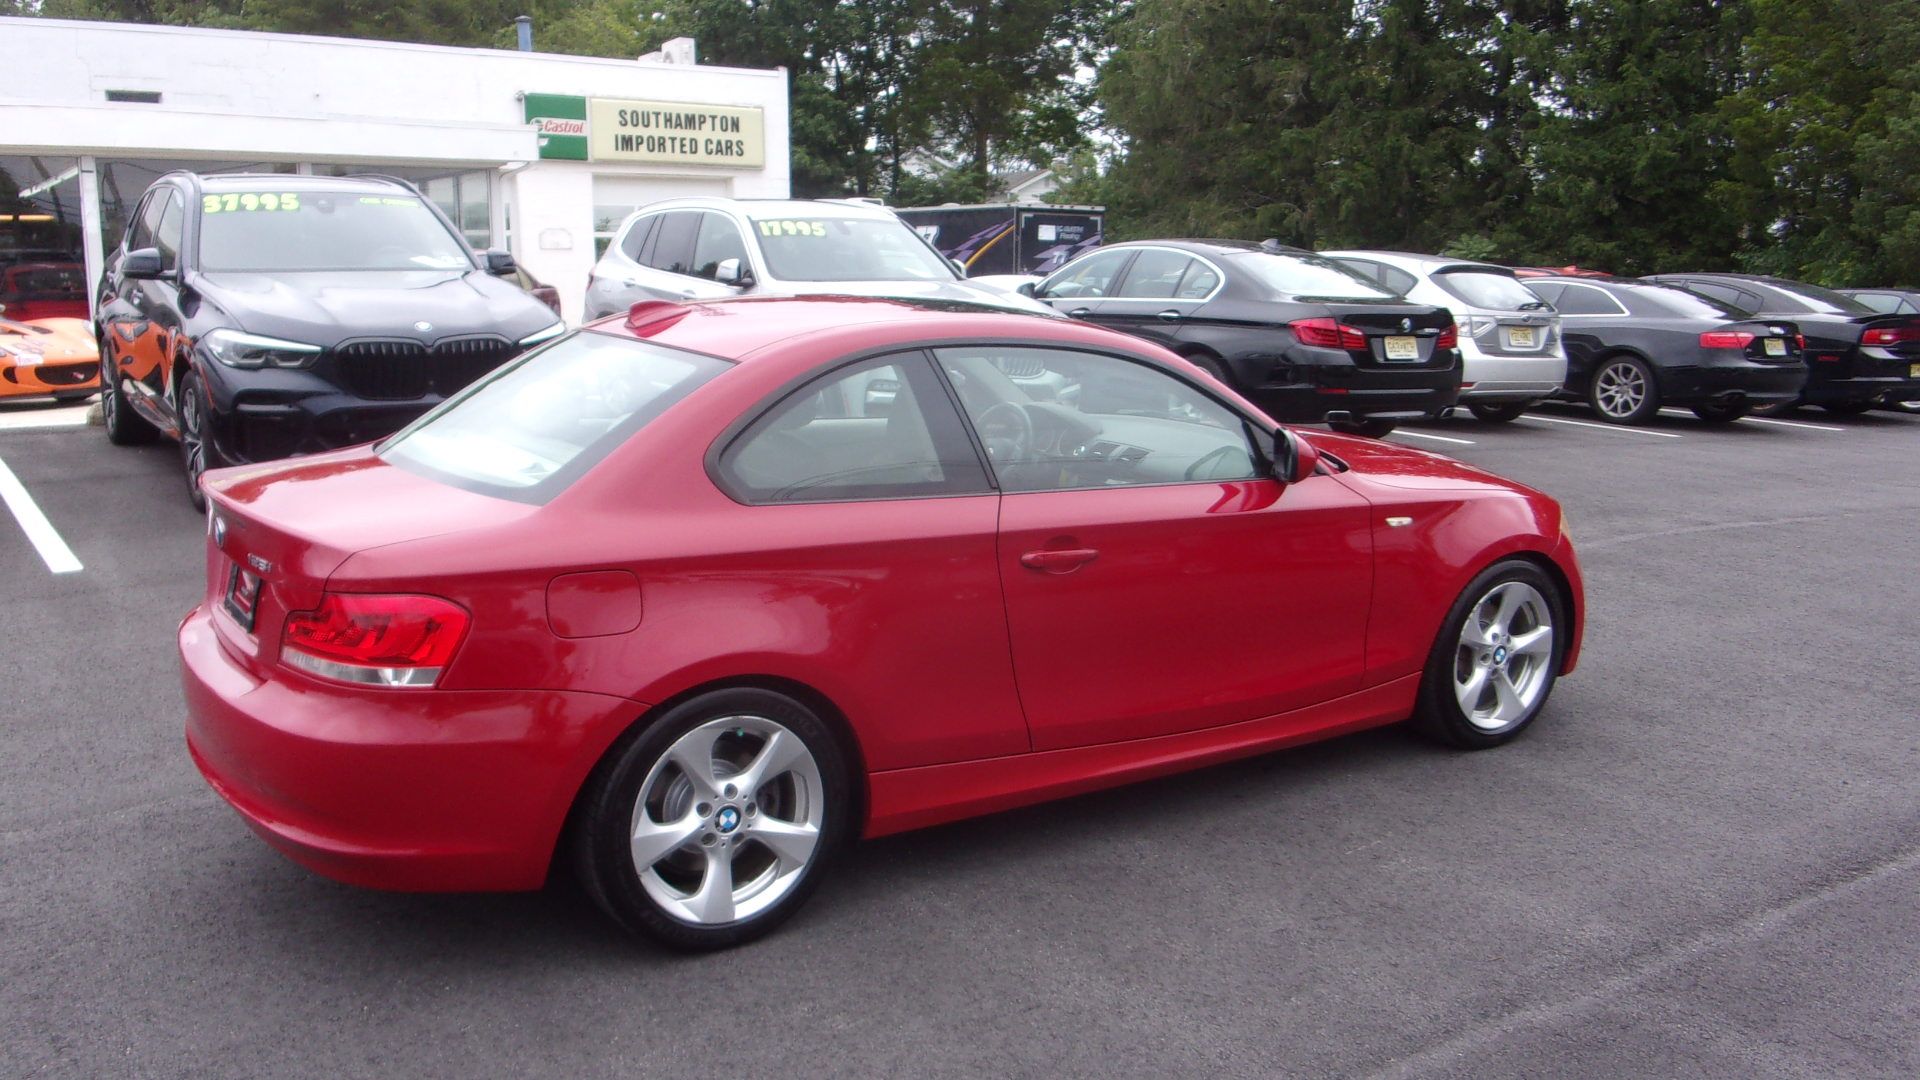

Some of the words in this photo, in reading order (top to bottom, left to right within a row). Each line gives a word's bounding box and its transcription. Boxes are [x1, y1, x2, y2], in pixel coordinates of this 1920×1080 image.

[544, 119, 584, 134] Castrol
[618, 108, 741, 133] SOUTHAMPTON
[614, 134, 699, 155] IMPORTED
[704, 138, 745, 157] CARS
[202, 192, 300, 214] 37995
[758, 220, 827, 237] 17995
